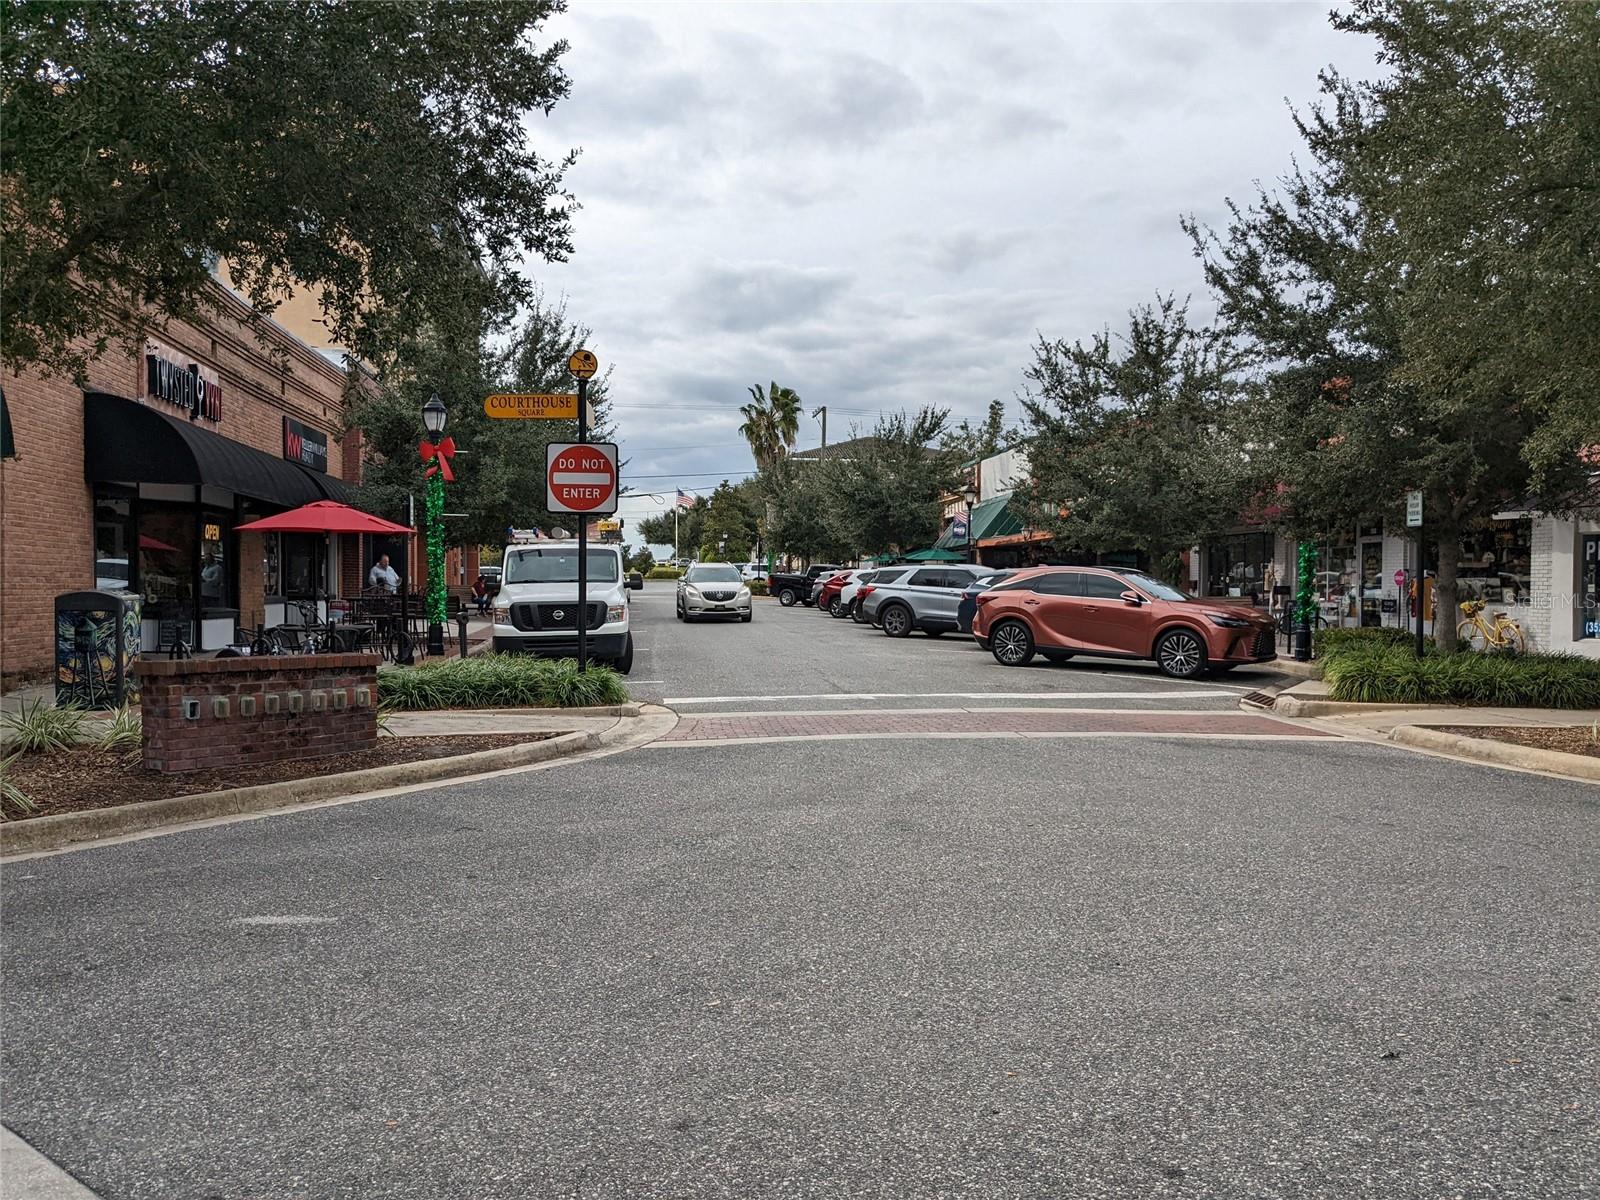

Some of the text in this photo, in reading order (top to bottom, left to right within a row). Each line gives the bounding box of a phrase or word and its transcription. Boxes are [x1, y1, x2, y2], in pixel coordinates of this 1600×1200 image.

[154, 355, 195, 410] TWYSTED
[490, 396, 572, 408] COURTHOUSE
[518, 409, 545, 417] SQUARE
[559, 459, 605, 469] DO NOT
[563, 488, 600, 498] ENTER
[205, 524, 220, 540] OPEN
